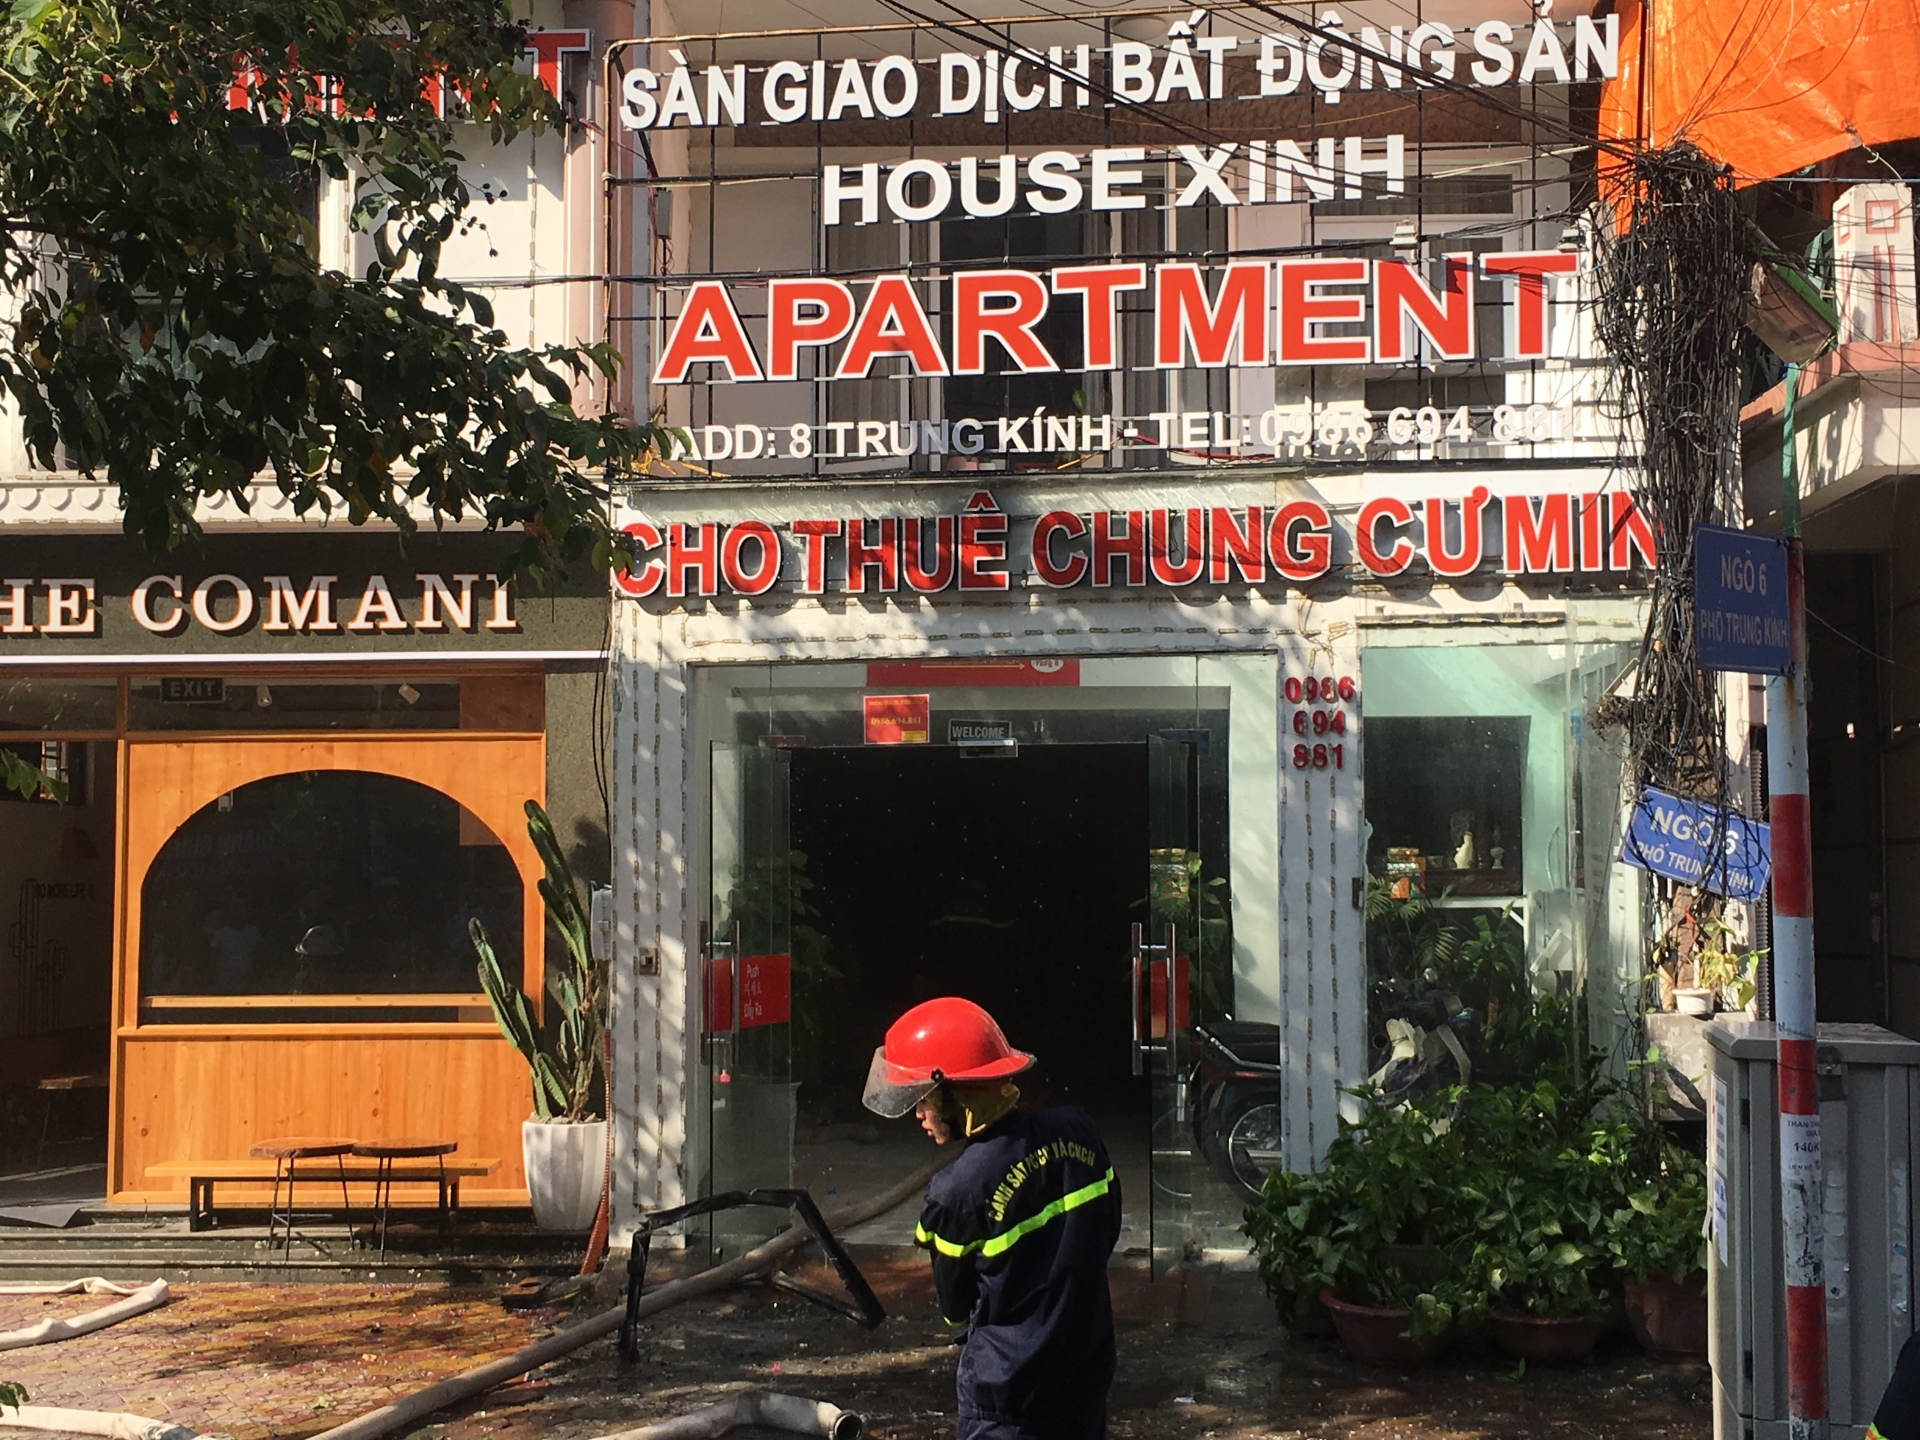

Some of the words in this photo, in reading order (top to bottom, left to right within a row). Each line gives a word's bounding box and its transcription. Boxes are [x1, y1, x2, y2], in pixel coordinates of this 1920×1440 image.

[619, 49, 745, 130] SÀN
[762, 55, 918, 123] GIAO
[940, 45, 1091, 124] DỊCH
[1112, 8, 1237, 104] BẤT
[1255, 11, 1456, 104] ĐỘNG
[1470, 0, 1619, 87] SẢN
[824, 147, 1147, 226] HOUSE
[1175, 134, 1405, 207] XINH
[652, 251, 1580, 384] APARTMENT
[670, 423, 776, 461] ADD:
[789, 423, 812, 459] 8
[827, 418, 984, 459] TRUNG
[999, 407, 1112, 454] KÍNH
[1149, 411, 1250, 448] TEL:
[1260, 407, 1373, 446] 0986
[1387, 406, 1470, 445] 694
[1493, 404, 1573, 442] 881
[612, 520, 781, 597] CHO
[790, 490, 1010, 596] THUÊ
[1031, 500, 1332, 589] CHUNG
[1355, 485, 1493, 577] CƯ
[1721, 549, 1755, 593] NGÕ
[1759, 563, 1767, 596] 6
[130, 573, 517, 632] COMANI
[1725, 612, 1762, 645] TRUNG
[170, 680, 215, 697] EXIT
[1285, 676, 1355, 703] 0986
[952, 726, 1004, 739] WELCOME
[1293, 710, 1345, 735] 694
[1293, 743, 1342, 770] 881
[1651, 806, 1716, 847] NGÕ
[1722, 830, 1739, 855] 6
[1005, 1161, 1030, 1189] SÁT
